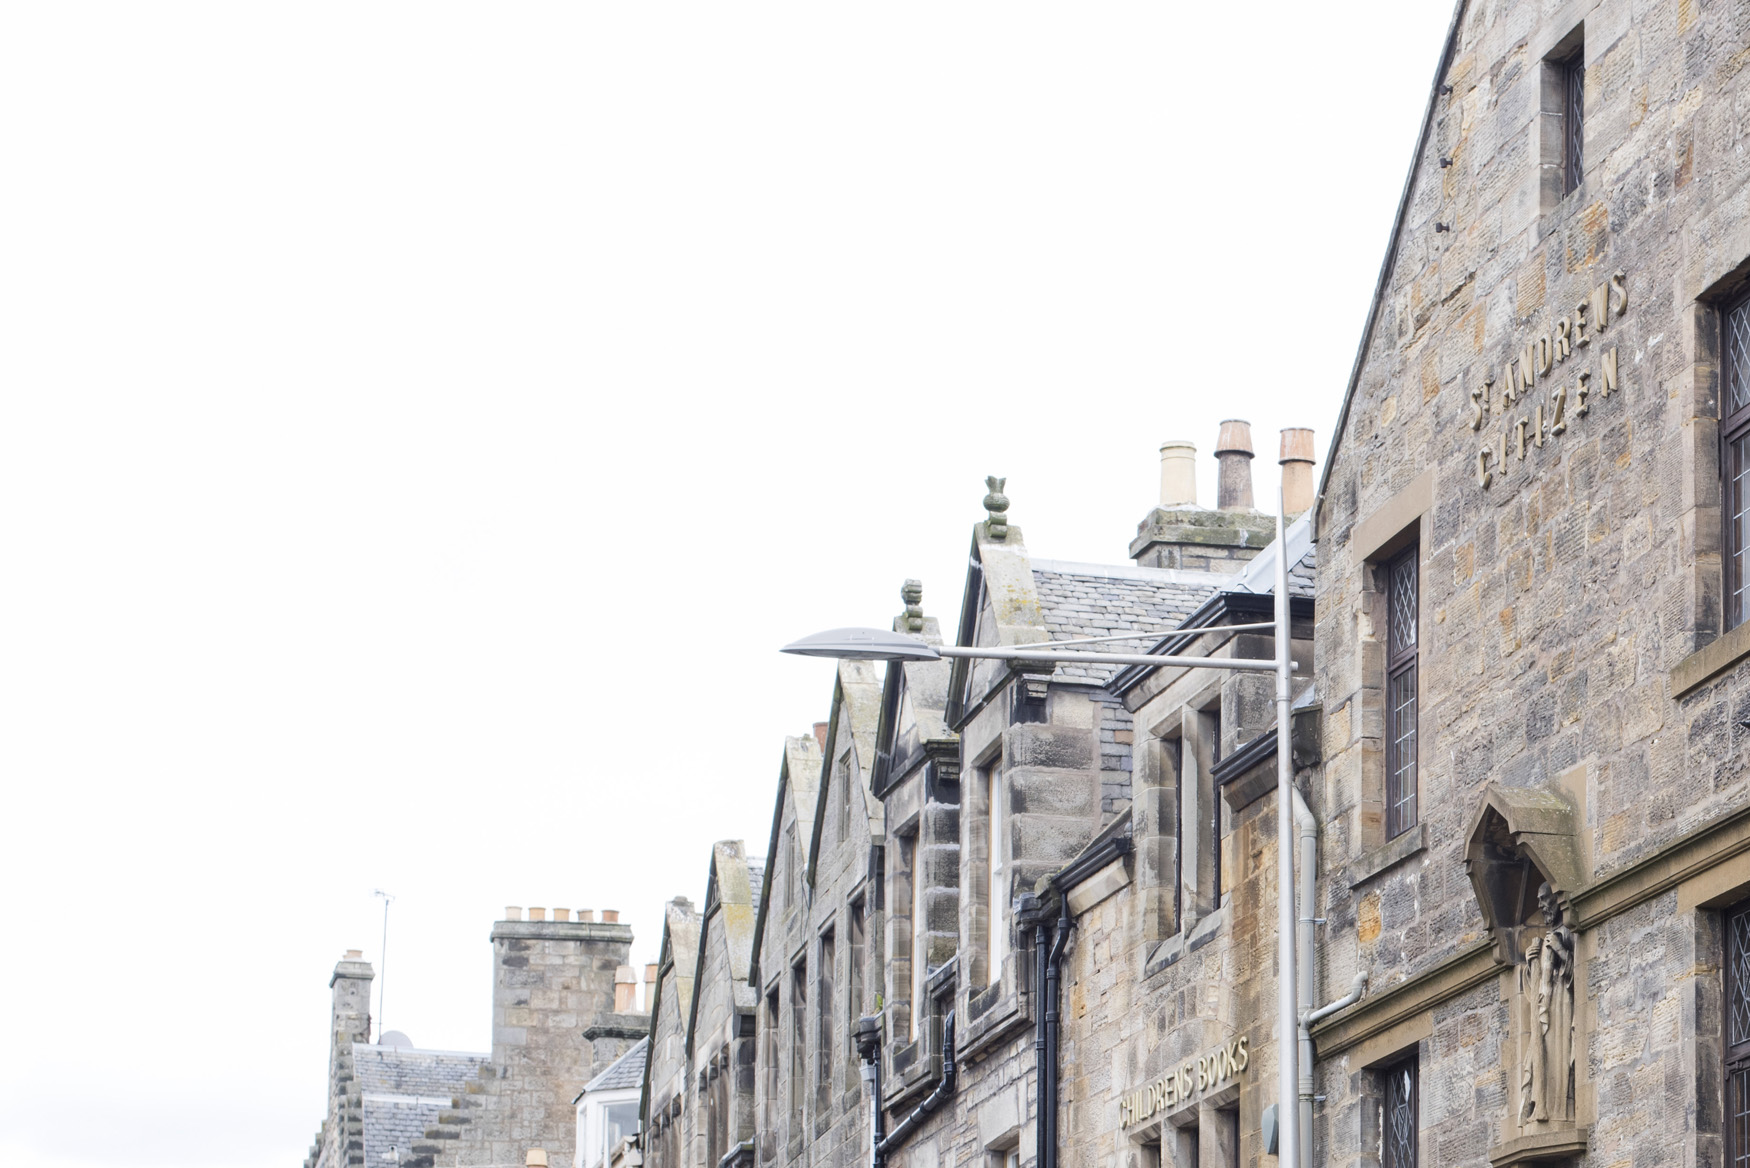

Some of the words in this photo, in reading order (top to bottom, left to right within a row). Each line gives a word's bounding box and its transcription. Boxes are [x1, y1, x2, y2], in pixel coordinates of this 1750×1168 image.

[1503, 268, 1628, 410] ANDREWS
[1479, 347, 1617, 489] CITIZEN
[1119, 1062, 1194, 1131] CHILDRENS
[1199, 1036, 1249, 1092] BOOKS
